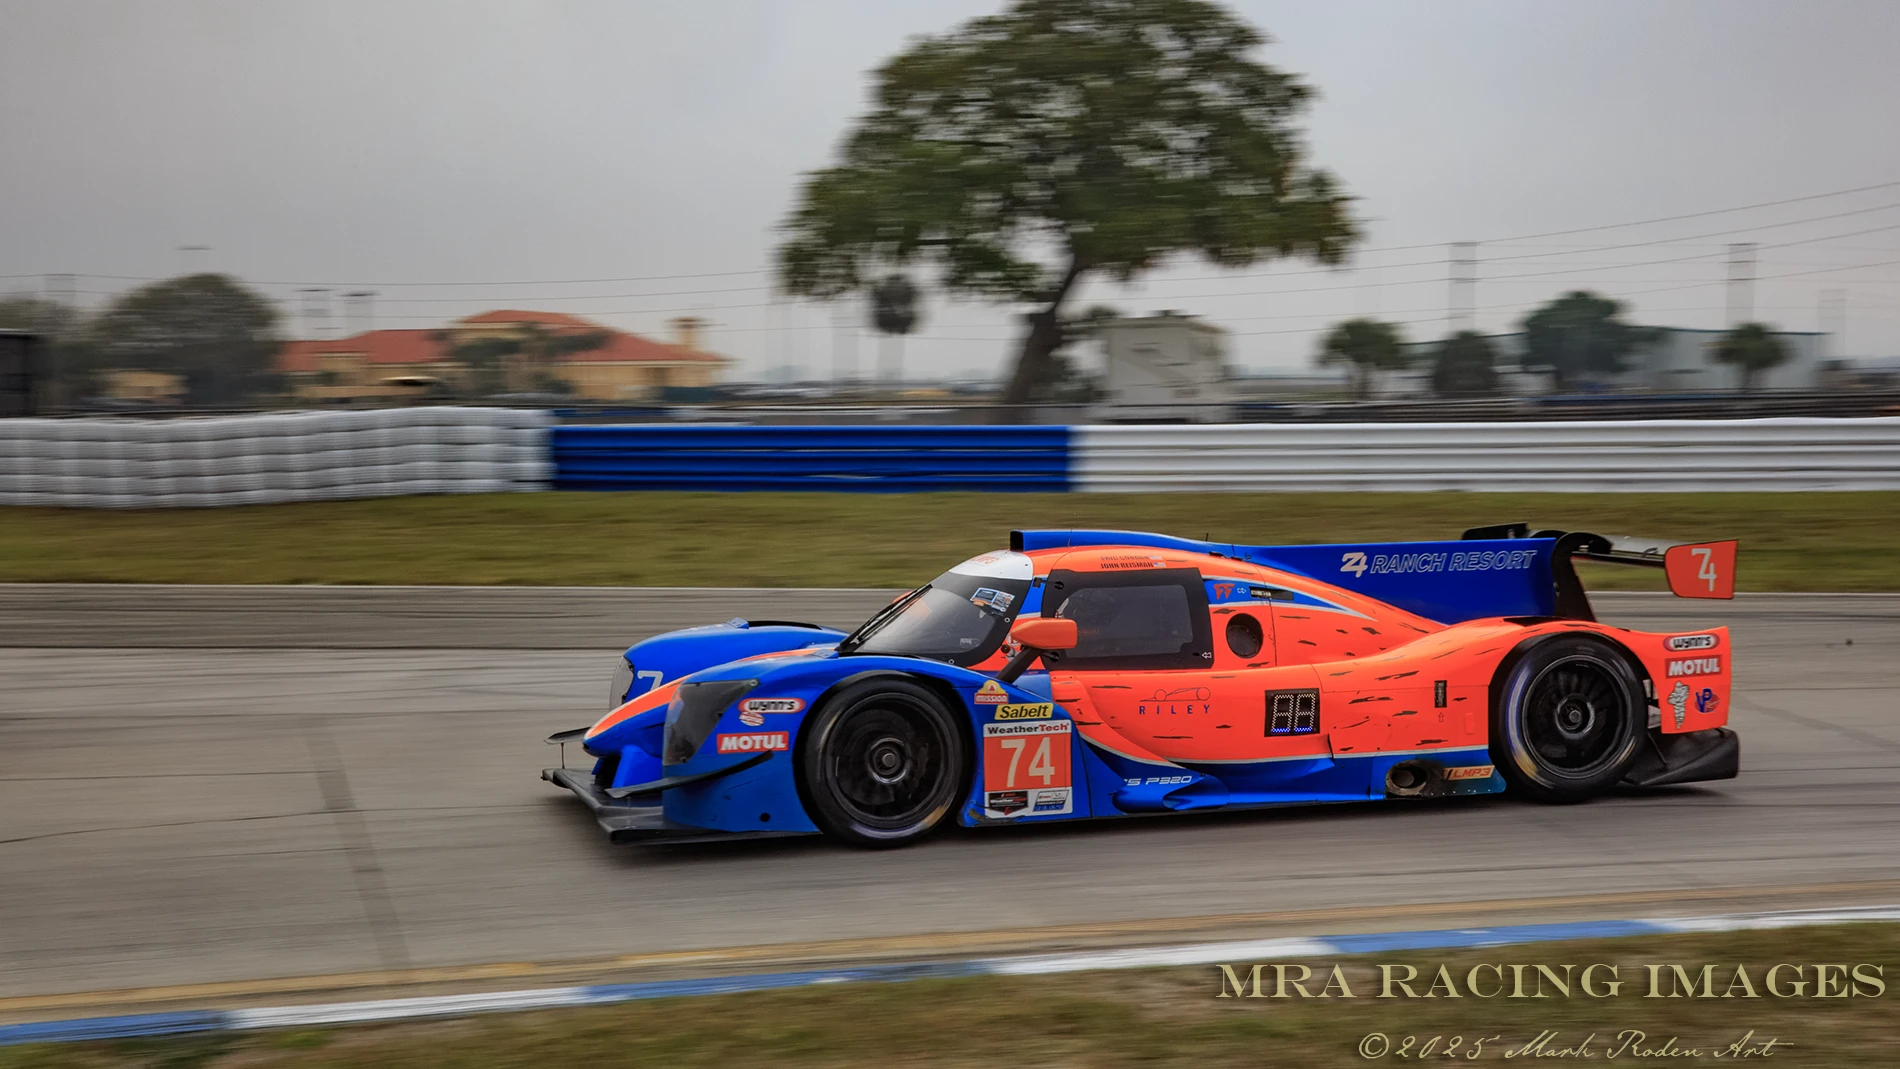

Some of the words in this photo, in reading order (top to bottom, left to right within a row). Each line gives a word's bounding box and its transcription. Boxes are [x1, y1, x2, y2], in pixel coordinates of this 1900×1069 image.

[1370, 553, 1447, 574] RANCH
[1448, 550, 1537, 572] RESORT
[1668, 658, 1720, 676] MOTUL
[999, 705, 1049, 719] Sabelt
[1139, 705, 1210, 715] RILEY
[987, 723, 1069, 734] WeatherTech
[720, 734, 786, 751] MOTUL
[1001, 737, 1055, 788] 74
[1453, 768, 1491, 778] LMP3
[1145, 776, 1192, 785] P320
